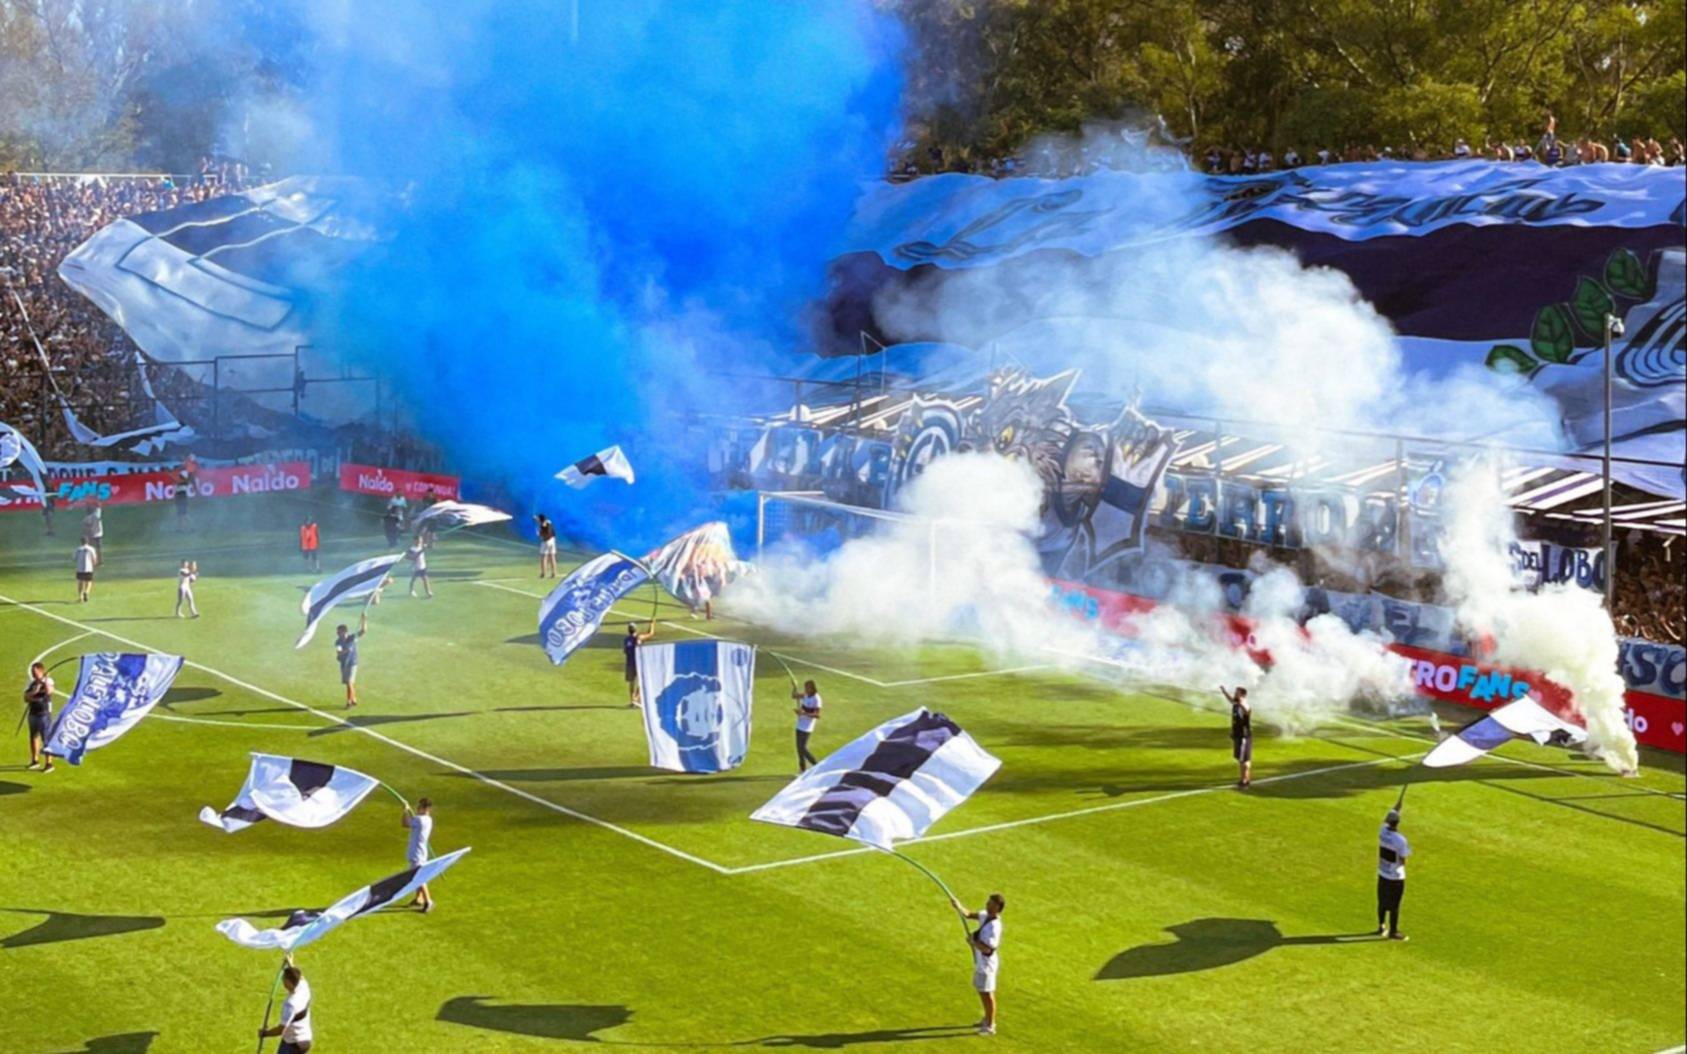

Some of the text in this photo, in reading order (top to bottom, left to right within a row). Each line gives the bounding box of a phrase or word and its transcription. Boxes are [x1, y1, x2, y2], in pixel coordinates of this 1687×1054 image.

[145, 478, 215, 500] Nado
[232, 471, 299, 493] Naldo
[358, 474, 394, 493] Naldo
[1541, 543, 1608, 592] LOBO
